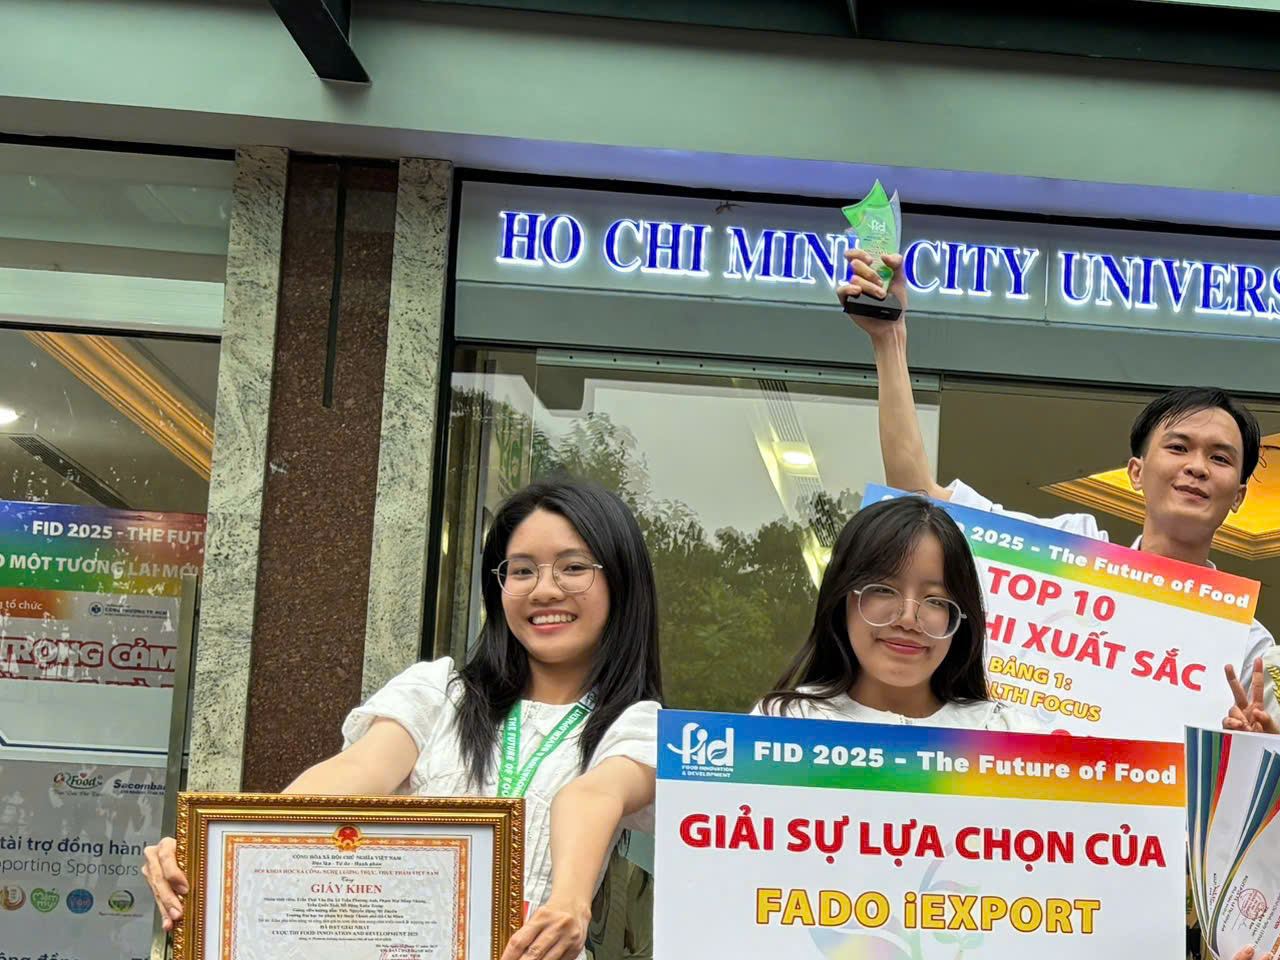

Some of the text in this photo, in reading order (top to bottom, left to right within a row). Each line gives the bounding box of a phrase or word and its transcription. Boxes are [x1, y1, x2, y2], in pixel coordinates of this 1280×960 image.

[495, 211, 584, 268] HO
[603, 218, 711, 277] CHI
[903, 241, 1039, 299] CITY
[32, 520, 64, 537] FID
[67, 523, 113, 540] 2025
[127, 527, 163, 543] THE
[167, 529, 207, 545] FUT
[10, 551, 54, 575] MỘT
[56, 557, 124, 578] TƯƠNG
[970, 526, 1024, 550] 2025
[1048, 545, 1087, 566] The
[1094, 556, 1164, 586] Future
[1171, 579, 1194, 592] of
[1199, 583, 1249, 608] Food
[18, 601, 43, 611] chức
[988, 567, 1115, 621] TOP 10
[984, 614, 1206, 691] HI XUẤT SẮC
[988, 655, 1073, 691] BẢNG 1:
[988, 682, 1101, 722] LTH FOCUS
[666, 722, 734, 767] fid
[755, 741, 802, 762] FID
[813, 745, 883, 767] 2025
[917, 751, 968, 772] The
[979, 755, 1069, 778] Future
[1079, 761, 1105, 780] of
[1115, 763, 1176, 784] Food
[113, 779, 166, 790] Sacomba
[27, 838, 53, 855] trợ
[57, 837, 104, 857] đồng
[679, 804, 1166, 872] GIẢI SỰ LỰA CHỌN CỦA
[66, 858, 139, 876] Sponsors
[311, 881, 383, 894] GIẤY KHEN
[757, 888, 1100, 933] FADO iEXPORT
